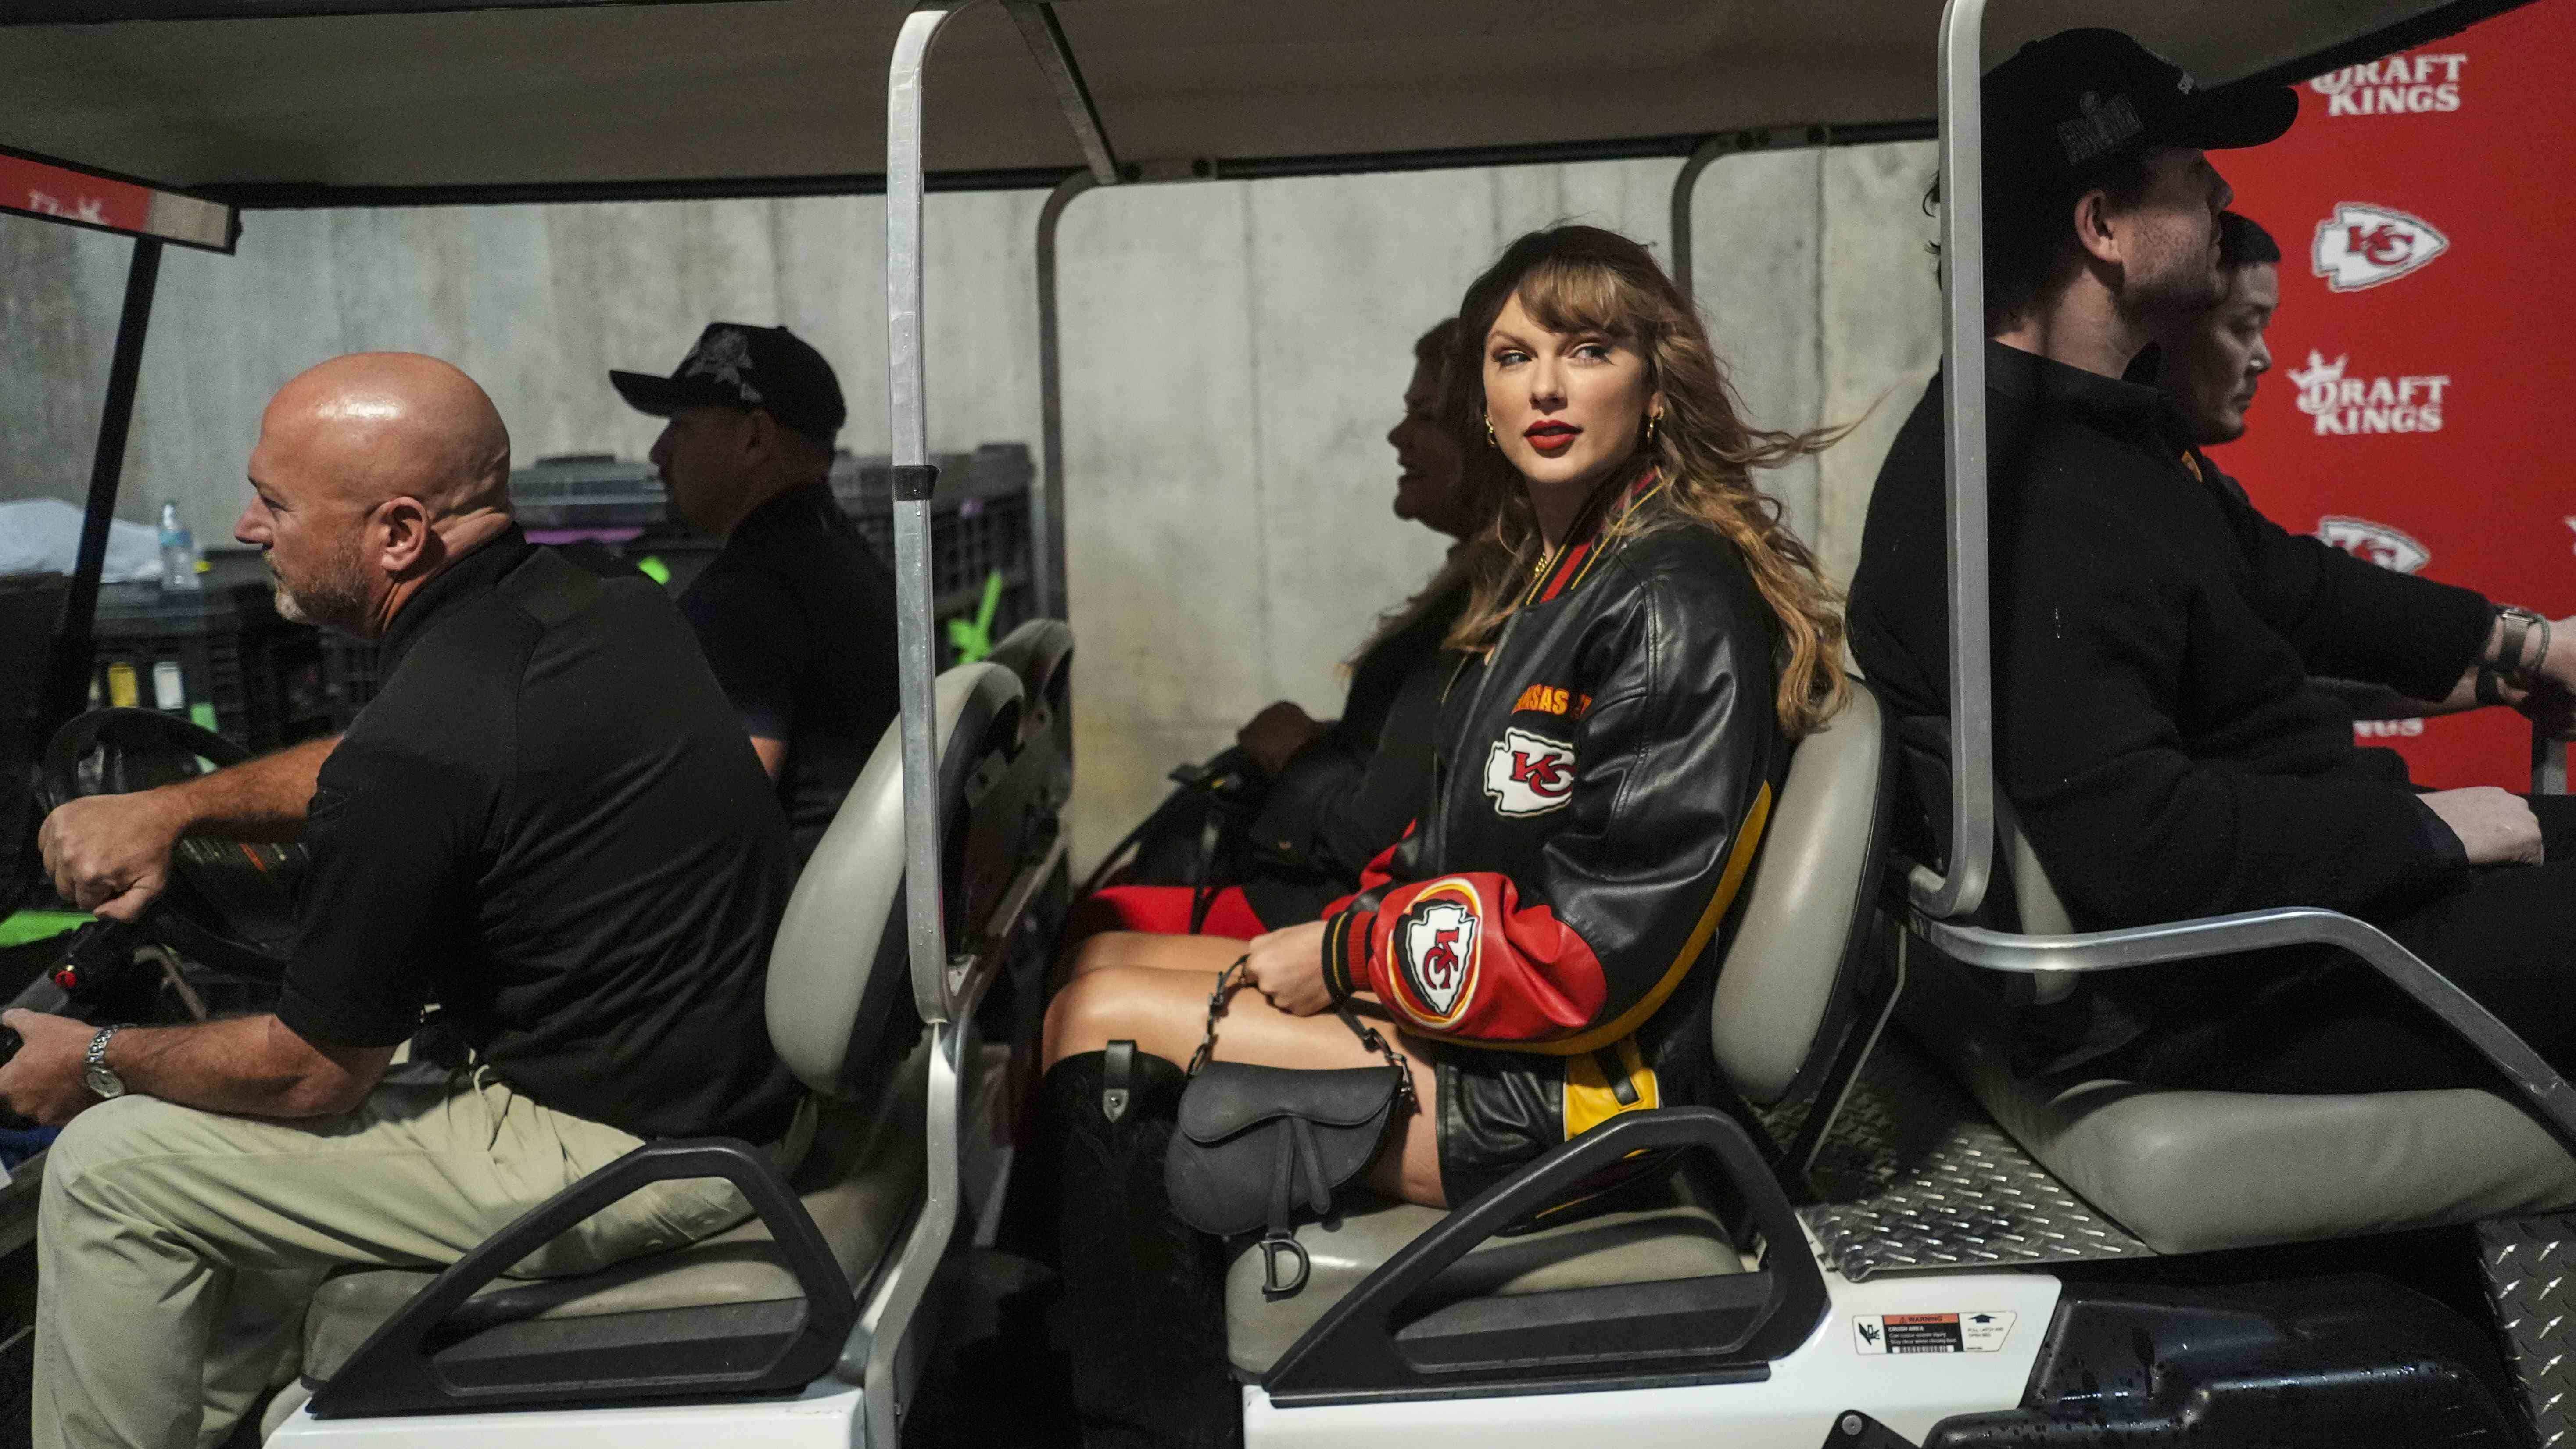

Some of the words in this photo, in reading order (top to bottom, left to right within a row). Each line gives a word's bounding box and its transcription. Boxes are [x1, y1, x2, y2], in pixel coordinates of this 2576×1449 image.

[2328, 83, 2461, 116] KINGS
[2347, 224, 2414, 265] KC
[2295, 375, 2451, 415] DRAFT
[2315, 404, 2443, 436] KINGS
[1508, 751, 1576, 798] KC
[1423, 927, 1460, 990] KC
